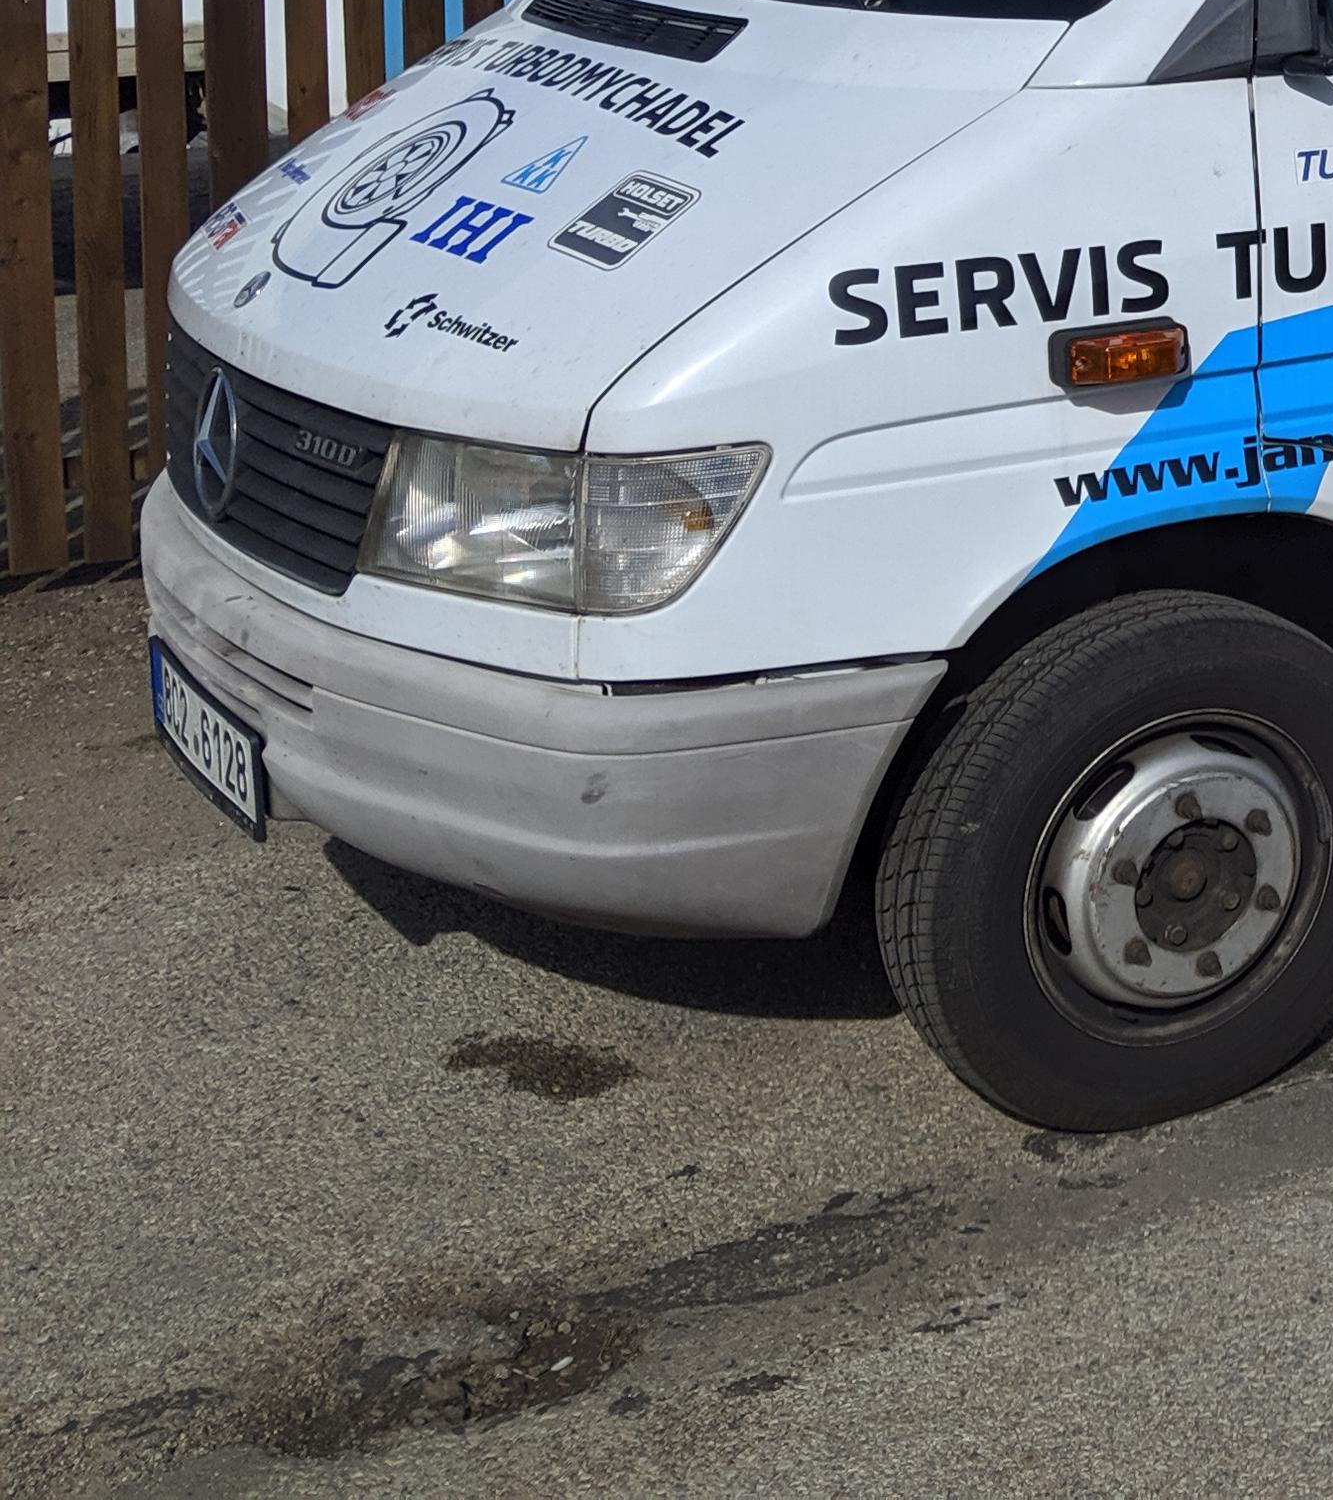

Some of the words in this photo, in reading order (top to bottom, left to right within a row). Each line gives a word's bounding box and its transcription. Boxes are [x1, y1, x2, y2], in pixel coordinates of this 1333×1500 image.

[473, 41, 745, 158] TURBODMYCHADEL
[409, 195, 535, 264] IHI
[617, 180, 685, 213] HOLSET
[567, 220, 639, 253] TURBO
[828, 238, 1171, 346] SERVIS
[427, 309, 519, 352] Schwitzer
[201, 708, 247, 803] 6128
